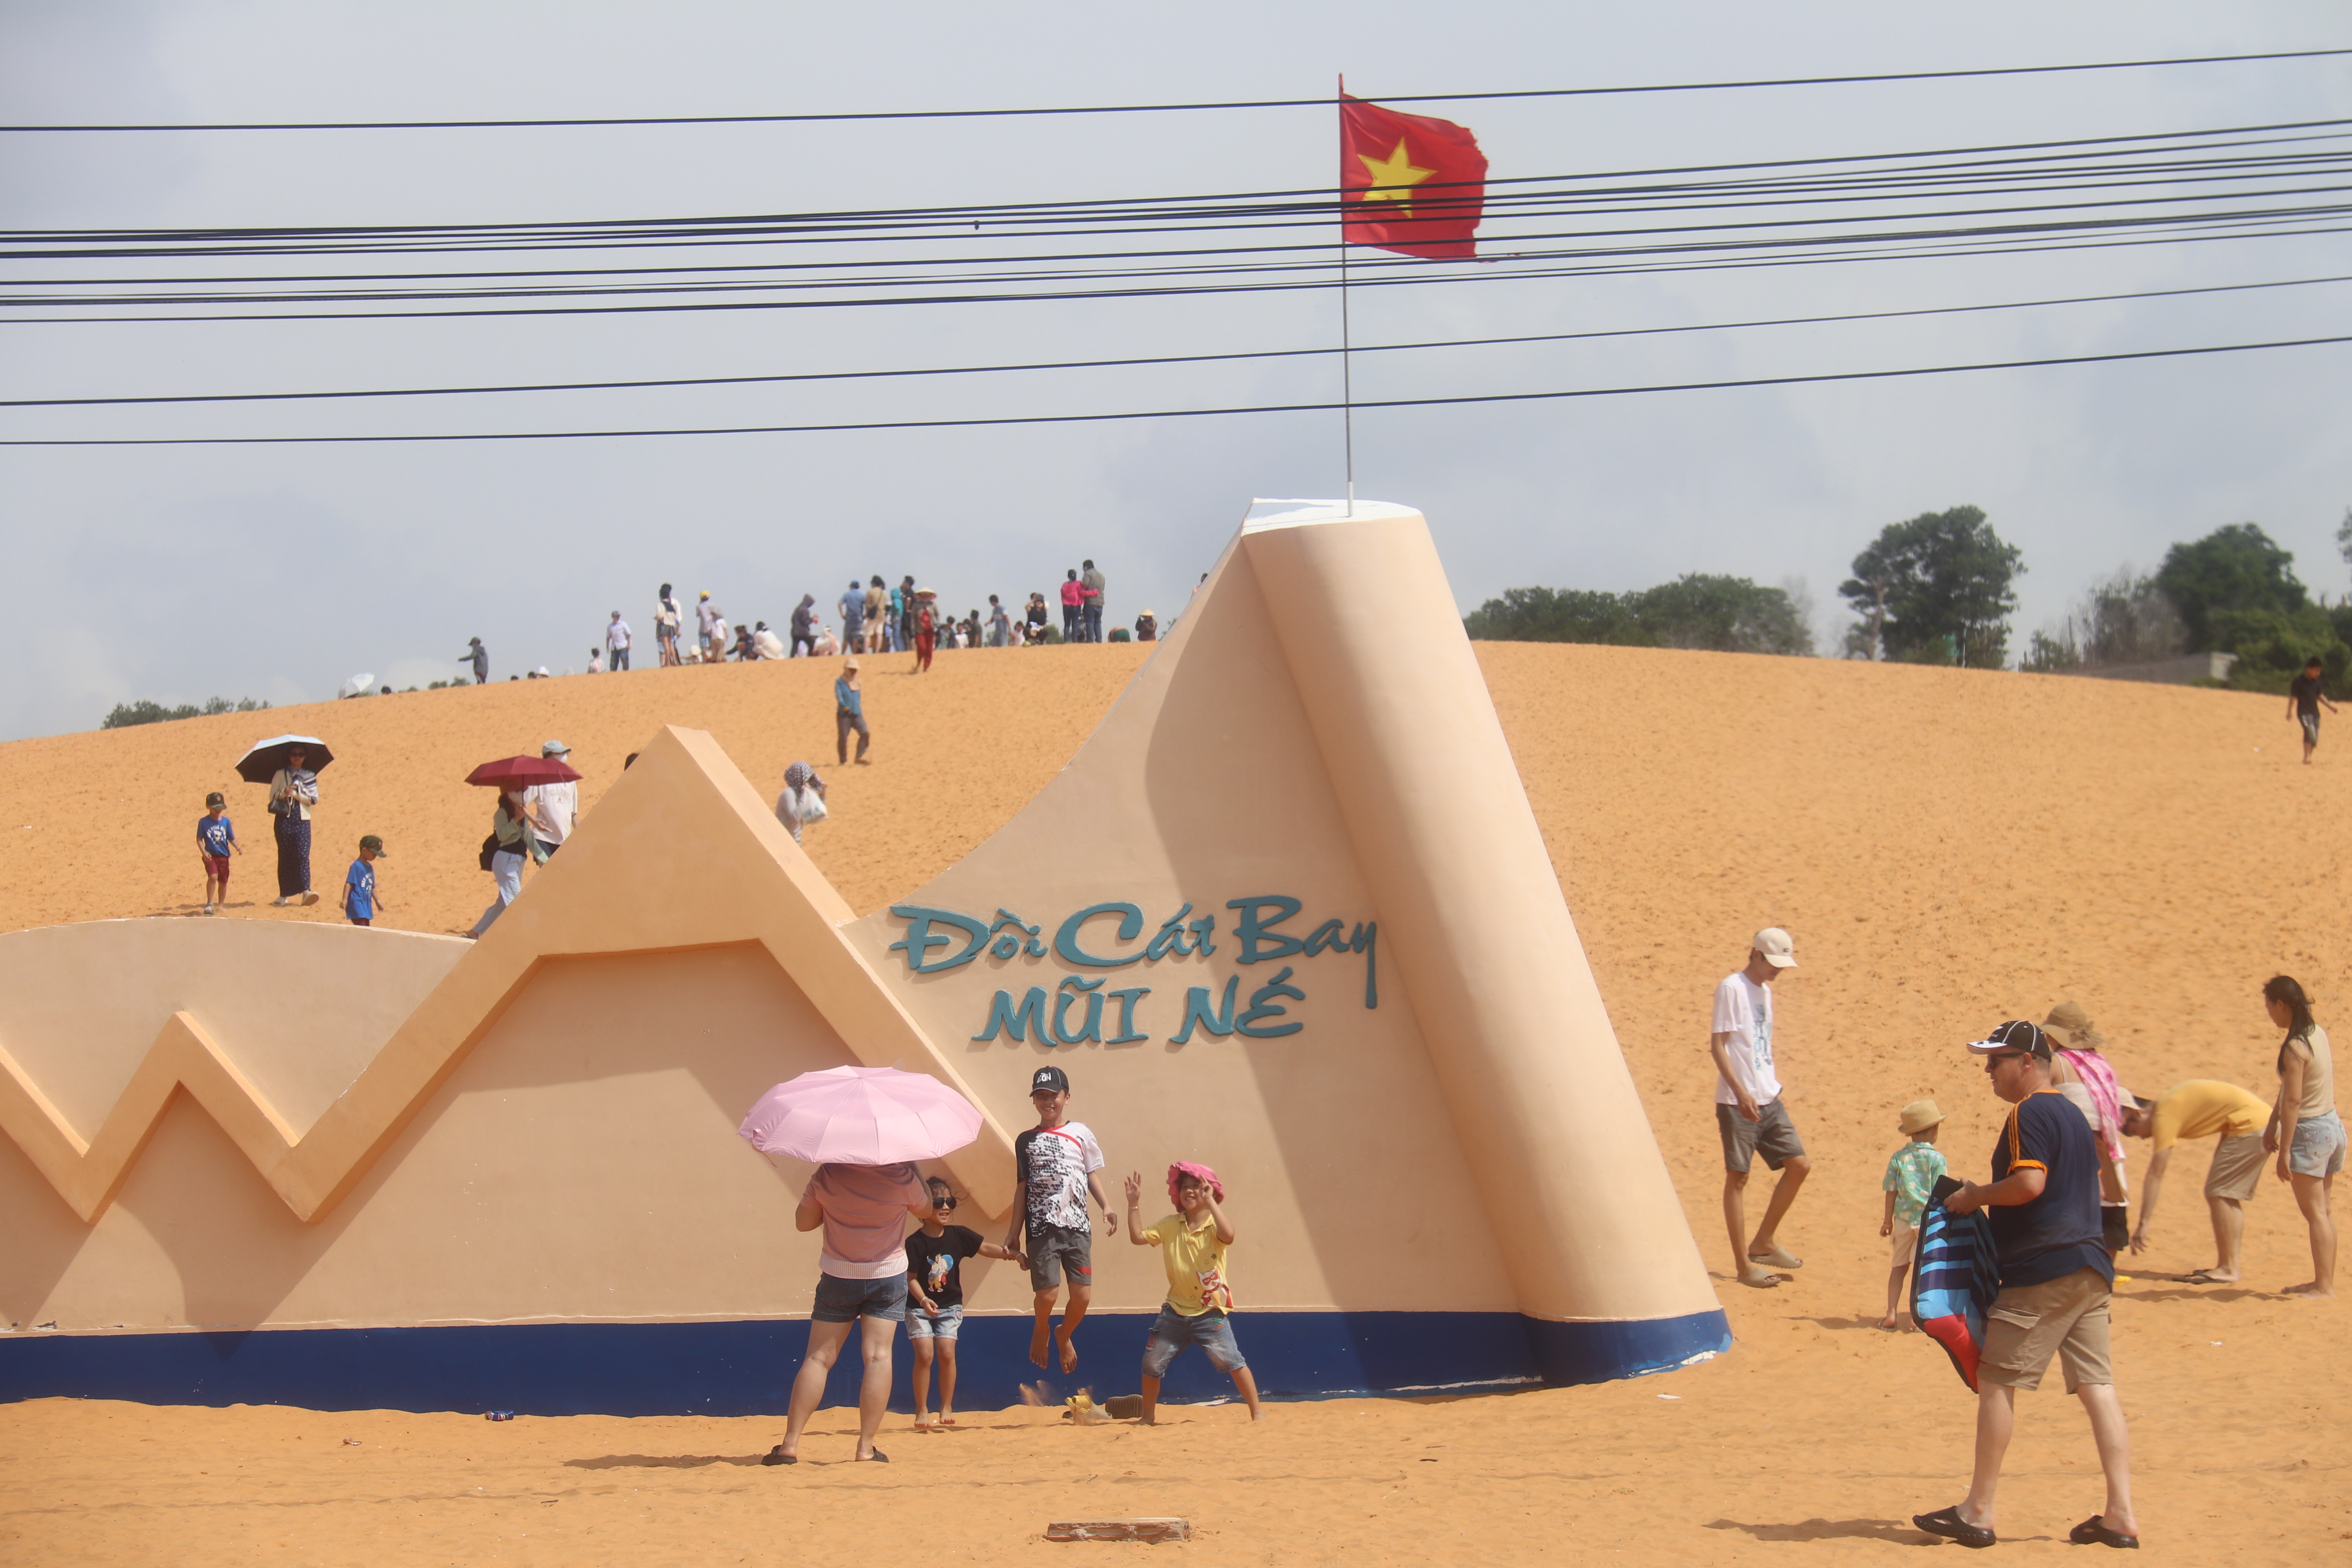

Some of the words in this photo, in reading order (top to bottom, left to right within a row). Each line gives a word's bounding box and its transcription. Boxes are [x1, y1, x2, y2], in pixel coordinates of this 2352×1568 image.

[890, 905, 1049, 973] Đồi
[1055, 902, 1216, 967] Cát
[1227, 895, 1376, 1009] Bay
[971, 975, 1151, 1046] MŨI
[1170, 966, 1305, 1043] NÉ
